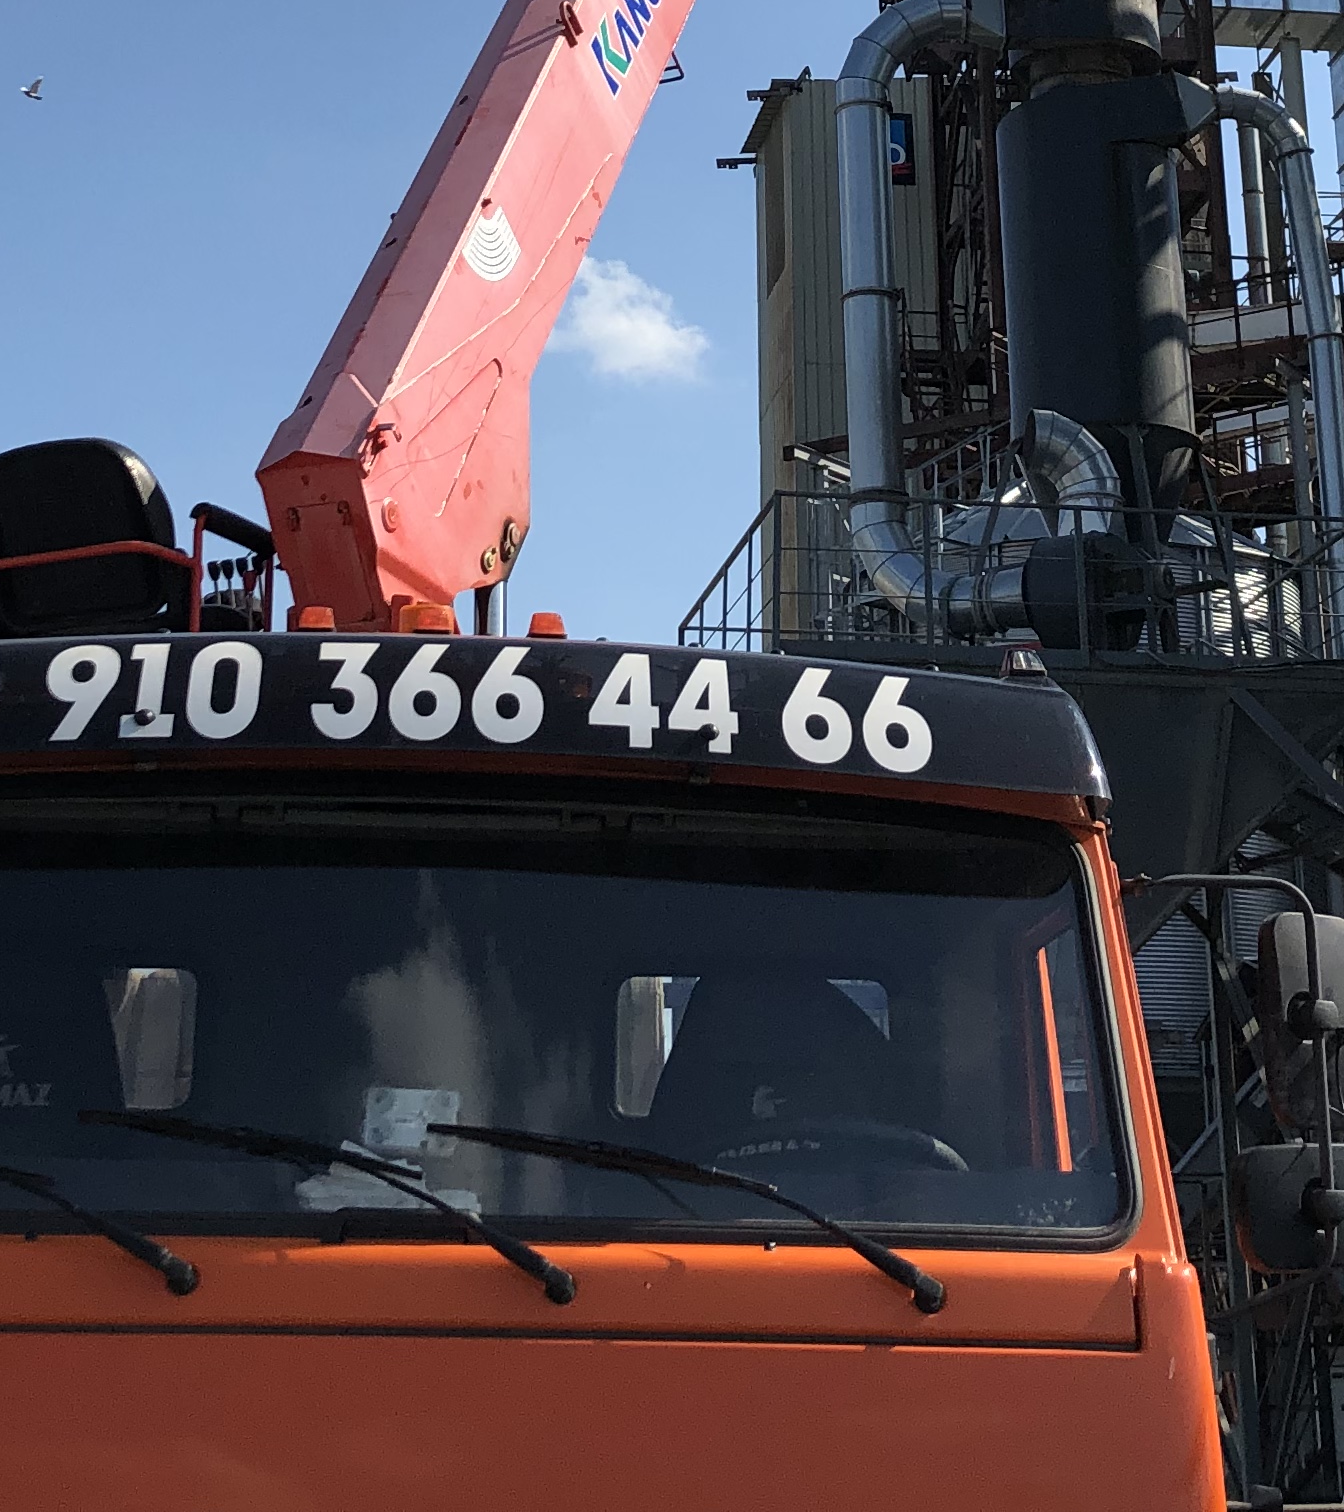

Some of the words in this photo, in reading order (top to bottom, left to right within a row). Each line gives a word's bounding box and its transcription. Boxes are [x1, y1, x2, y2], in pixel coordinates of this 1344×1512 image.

[46, 641, 263, 741] 910
[311, 642, 544, 744] 366
[588, 653, 739, 754] 44
[781, 666, 933, 773] 66
